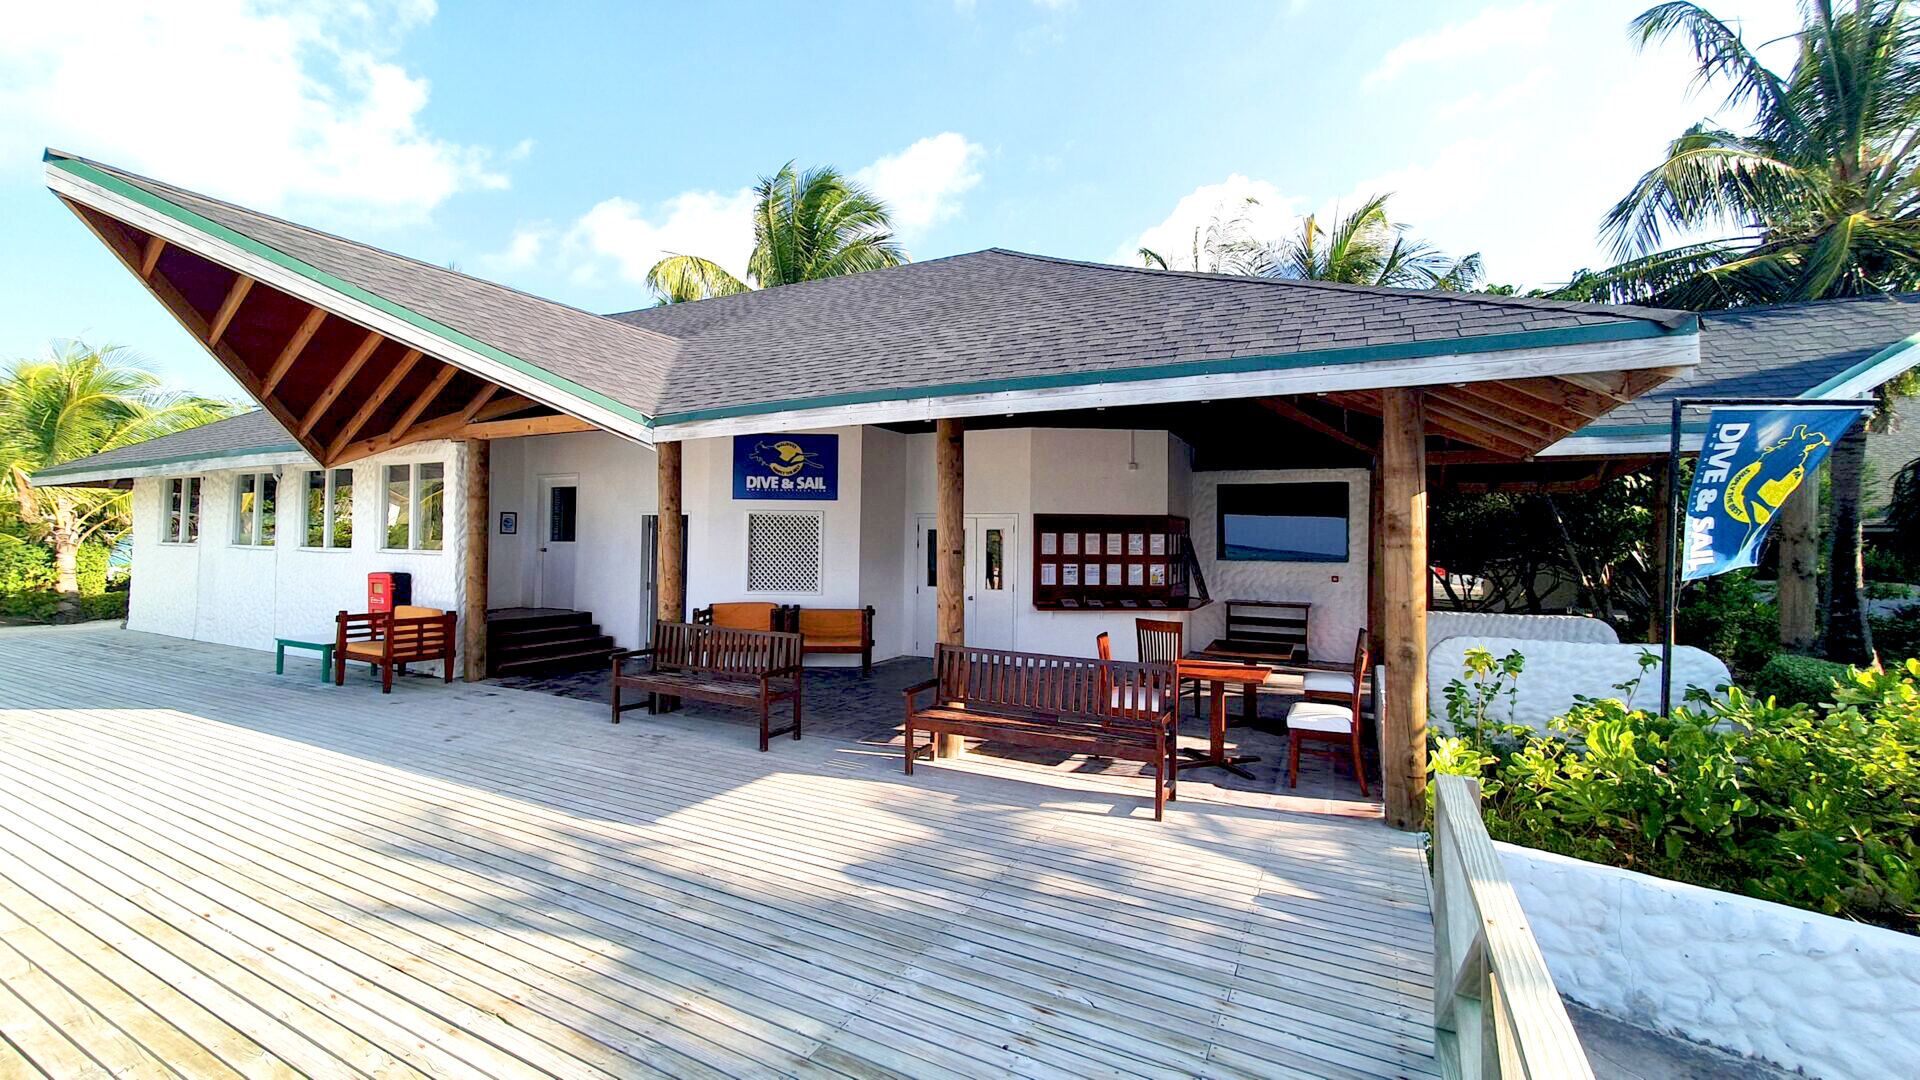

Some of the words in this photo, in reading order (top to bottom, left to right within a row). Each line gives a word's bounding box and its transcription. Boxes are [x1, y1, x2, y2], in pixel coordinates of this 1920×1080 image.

[1702, 423, 1751, 484] DIVE
[746, 476, 779, 489] DIVE
[781, 478, 794, 489] &
[797, 477, 826, 490] SAIL
[1729, 467, 1751, 491] SIMPLY
[1695, 488, 1718, 512] &
[1726, 491, 1735, 505] THE
[1687, 516, 1715, 573] SAIL
